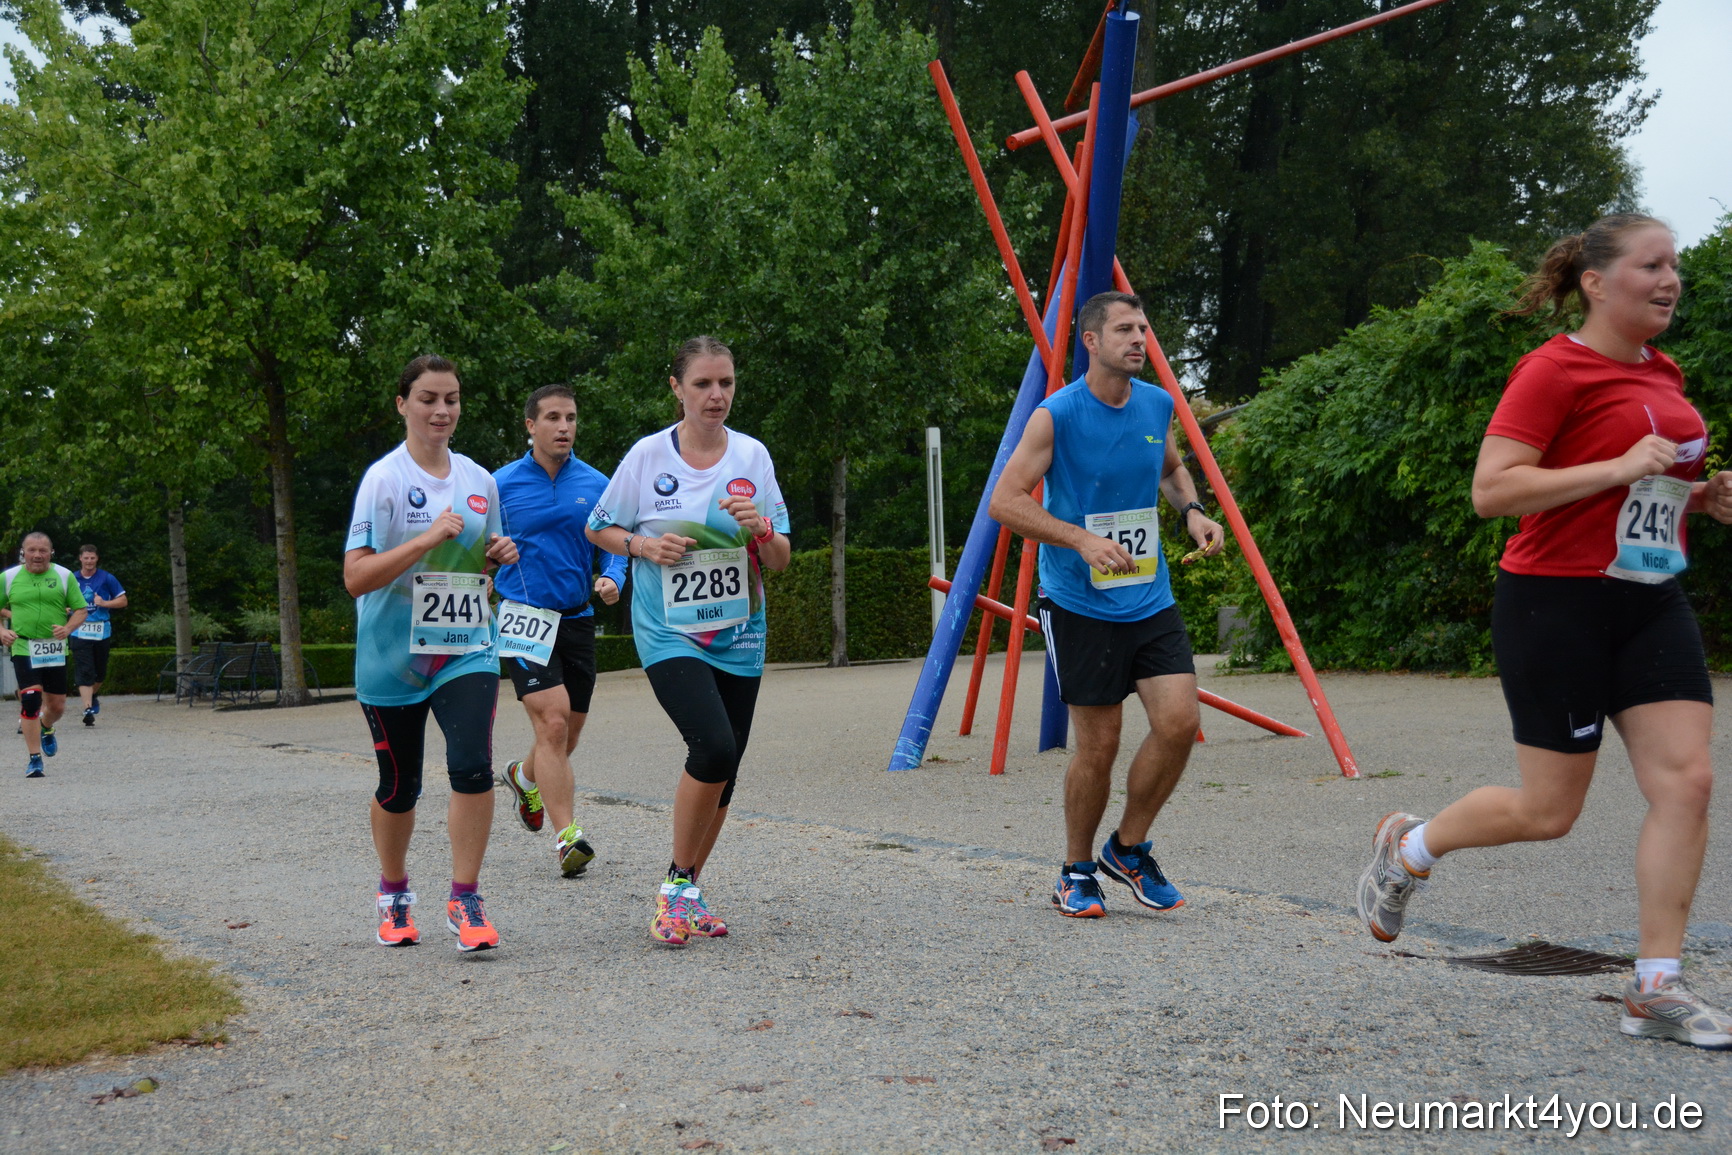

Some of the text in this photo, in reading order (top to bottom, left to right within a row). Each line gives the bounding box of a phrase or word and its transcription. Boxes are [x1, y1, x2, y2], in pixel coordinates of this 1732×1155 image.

[730, 483, 753, 495] Hervis
[655, 499, 682, 508] PARTL
[1626, 499, 1676, 544] 2431
[699, 550, 741, 563] BOCK
[1641, 552, 1670, 570] Nicole
[671, 566, 741, 603] 2283
[422, 592, 483, 623] 2441
[696, 605, 723, 621] Nicki
[81, 623, 102, 633] 2118
[500, 612, 553, 641] 2507
[443, 631, 469, 643] Jana
[33, 642, 63, 656] 2504
[504, 640, 535, 653] Manuel
